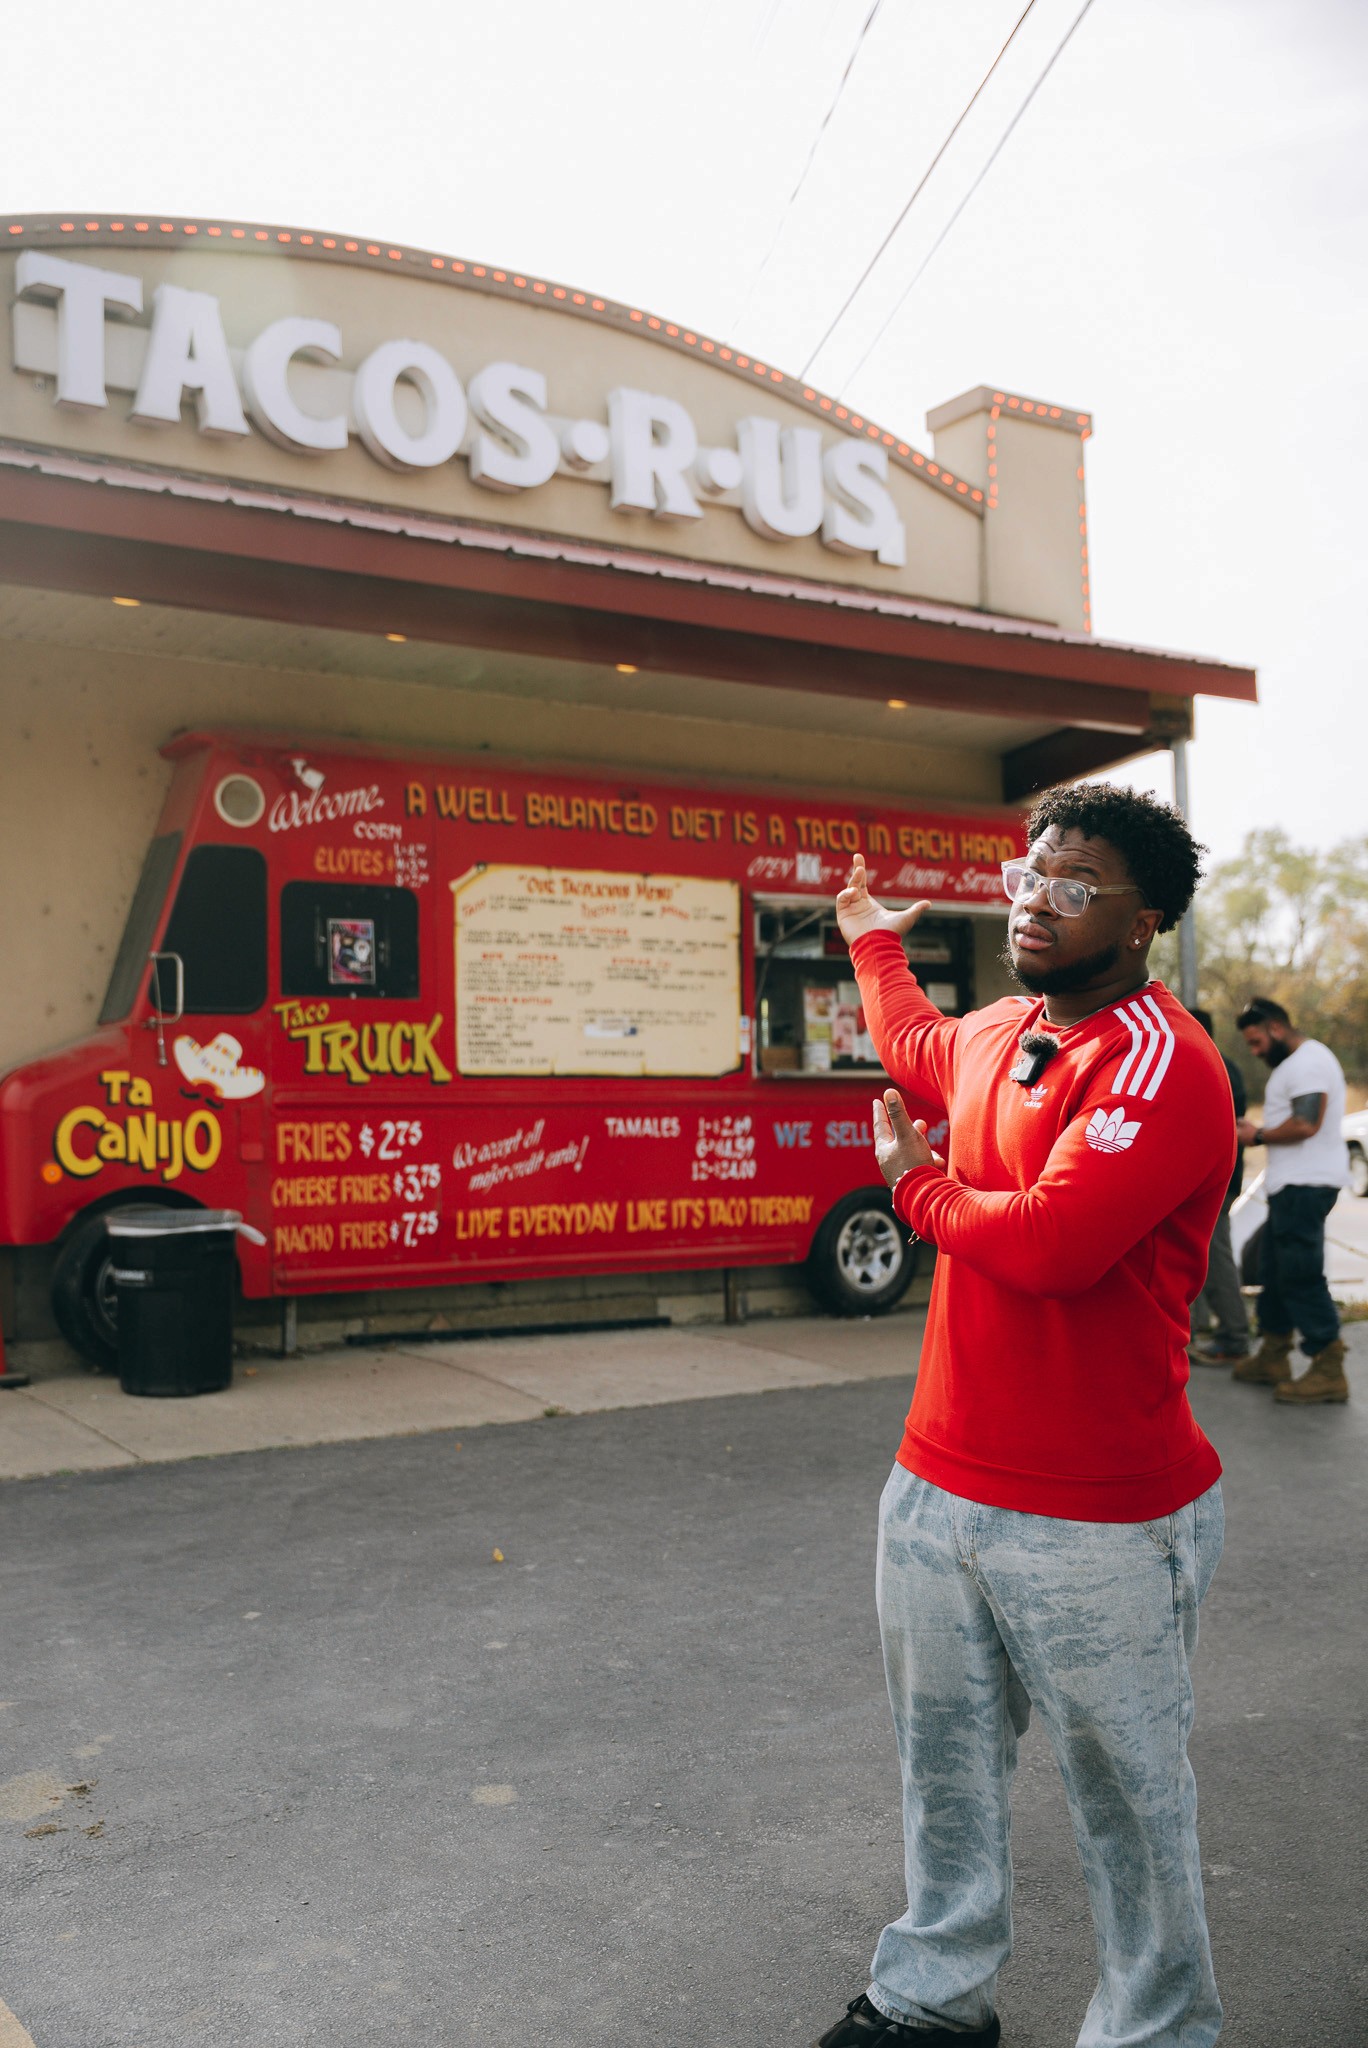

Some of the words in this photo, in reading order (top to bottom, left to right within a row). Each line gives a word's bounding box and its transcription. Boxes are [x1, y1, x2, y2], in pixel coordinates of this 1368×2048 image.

[268, 784, 385, 833] Welcome
[406, 781, 427, 816] A
[436, 785, 518, 824] WELL
[525, 792, 658, 837] BALANCED
[671, 806, 725, 841] DIET
[734, 811, 760, 844] IS
[768, 814, 786, 847] A
[795, 817, 860, 852] TACO
[867, 823, 891, 856] IN
[899, 826, 954, 861] EACH
[960, 832, 1016, 864] HAND
[353, 820, 402, 839] CORN
[273, 1001, 330, 1030] Taco
[290, 1014, 452, 1083] TRUCK
[101, 1071, 153, 1107] Ta
[276, 1121, 352, 1164] FRIES
[604, 1117, 680, 1138] TAMALES
[773, 1121, 812, 1148] WE
[825, 1119, 872, 1148] SELL
[271, 1174, 338, 1208] CHEESE
[340, 1173, 391, 1204] FRIES
[456, 1208, 502, 1240] LIVE
[508, 1202, 618, 1237] EVERYDAY
[626, 1200, 667, 1232] LIKE
[708, 1196, 747, 1226] TACO
[749, 1194, 815, 1226] TUESDAY
[275, 1223, 335, 1255] NACHO
[340, 1221, 388, 1250] FRIES
